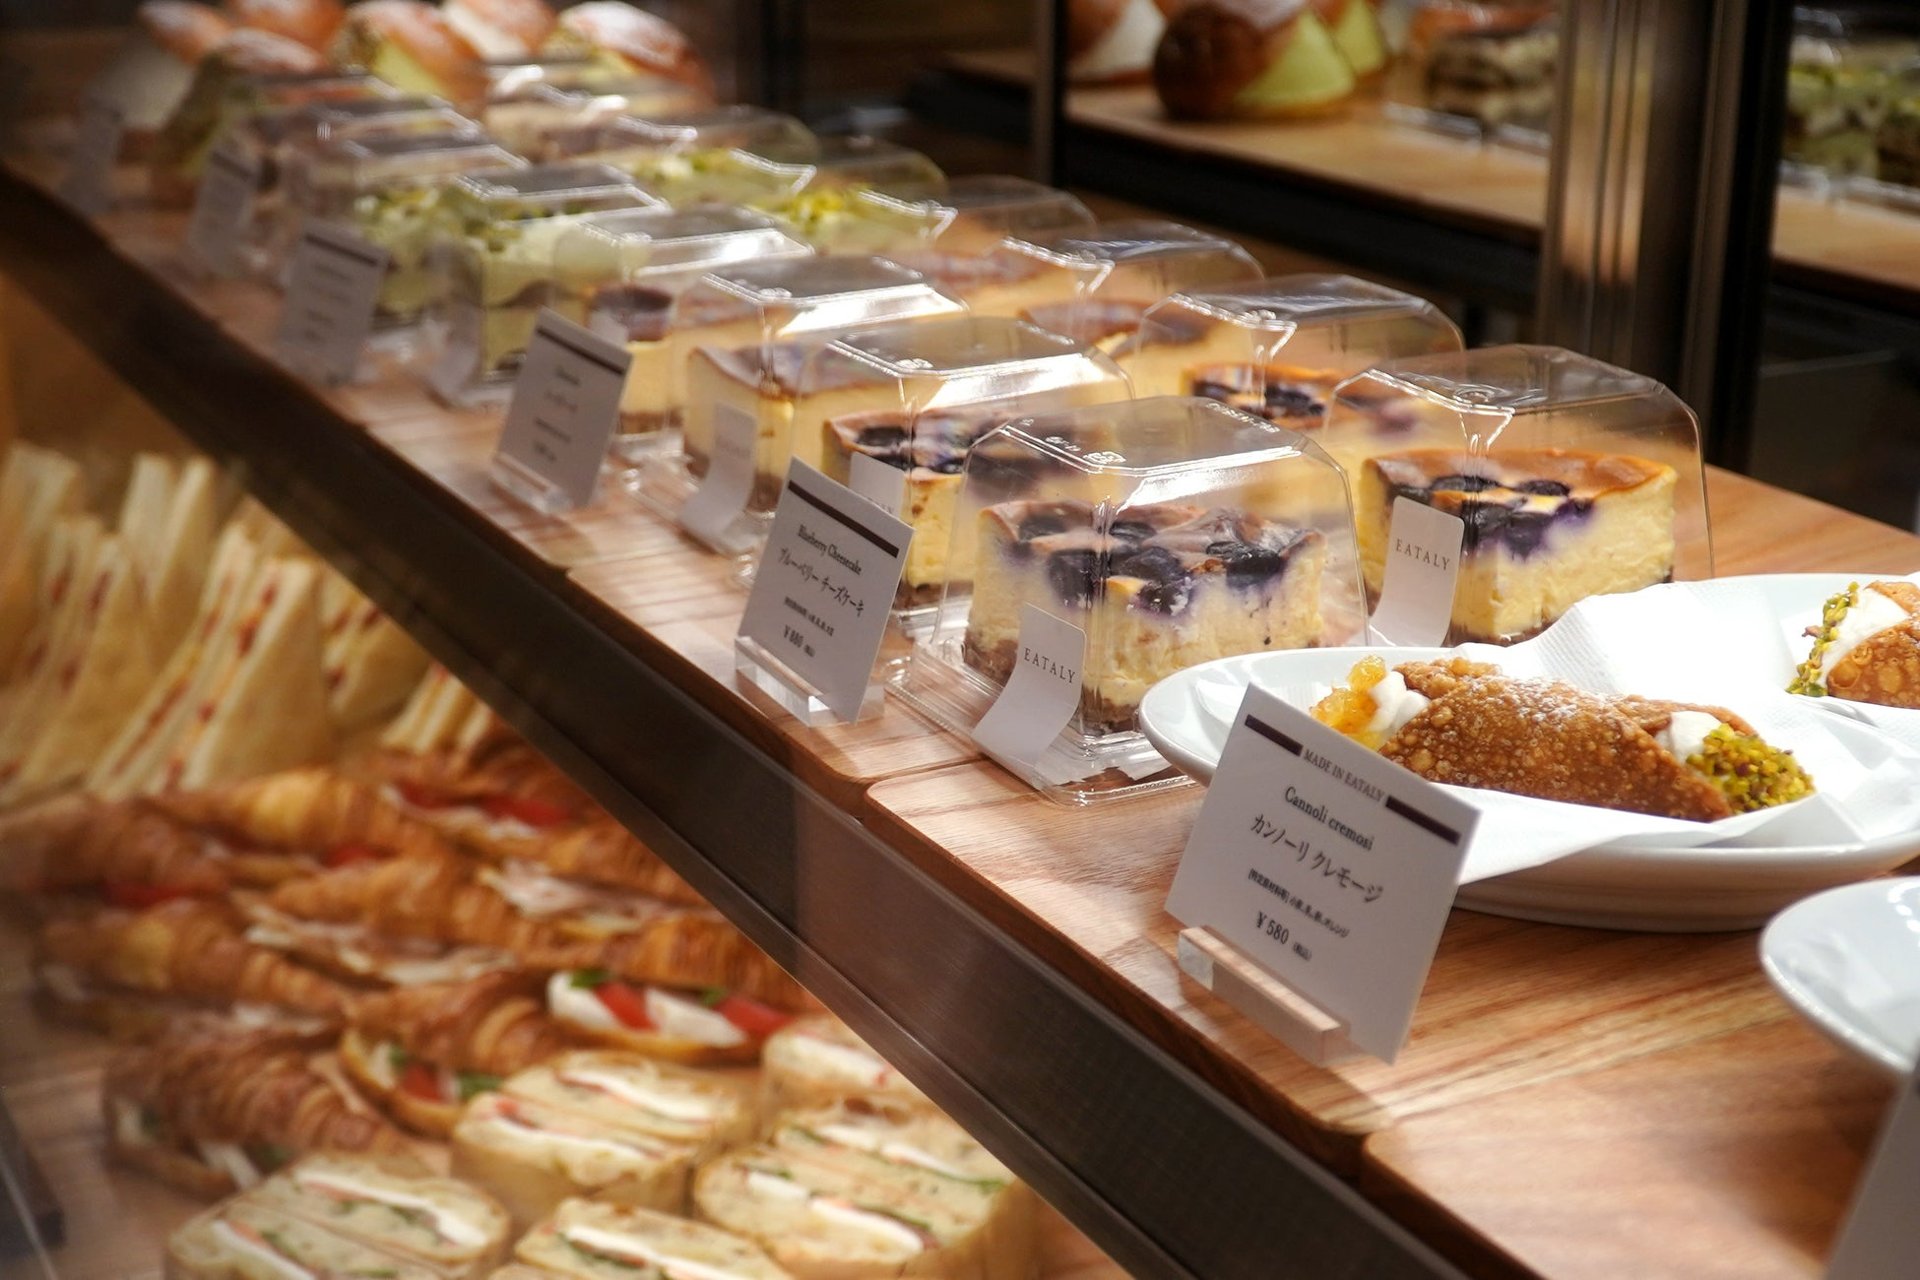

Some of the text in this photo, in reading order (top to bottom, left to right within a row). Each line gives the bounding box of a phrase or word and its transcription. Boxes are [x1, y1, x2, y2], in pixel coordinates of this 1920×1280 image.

[1396, 538, 1450, 571] EATALY
[1024, 647, 1076, 684] EATALY
[1304, 749, 1385, 802] MADE IN EATALY
[1285, 786, 1375, 851] Cannoli cremosi
[1251, 814, 1310, 862] カンノーリ
[1311, 851, 1384, 903] クレモージ
